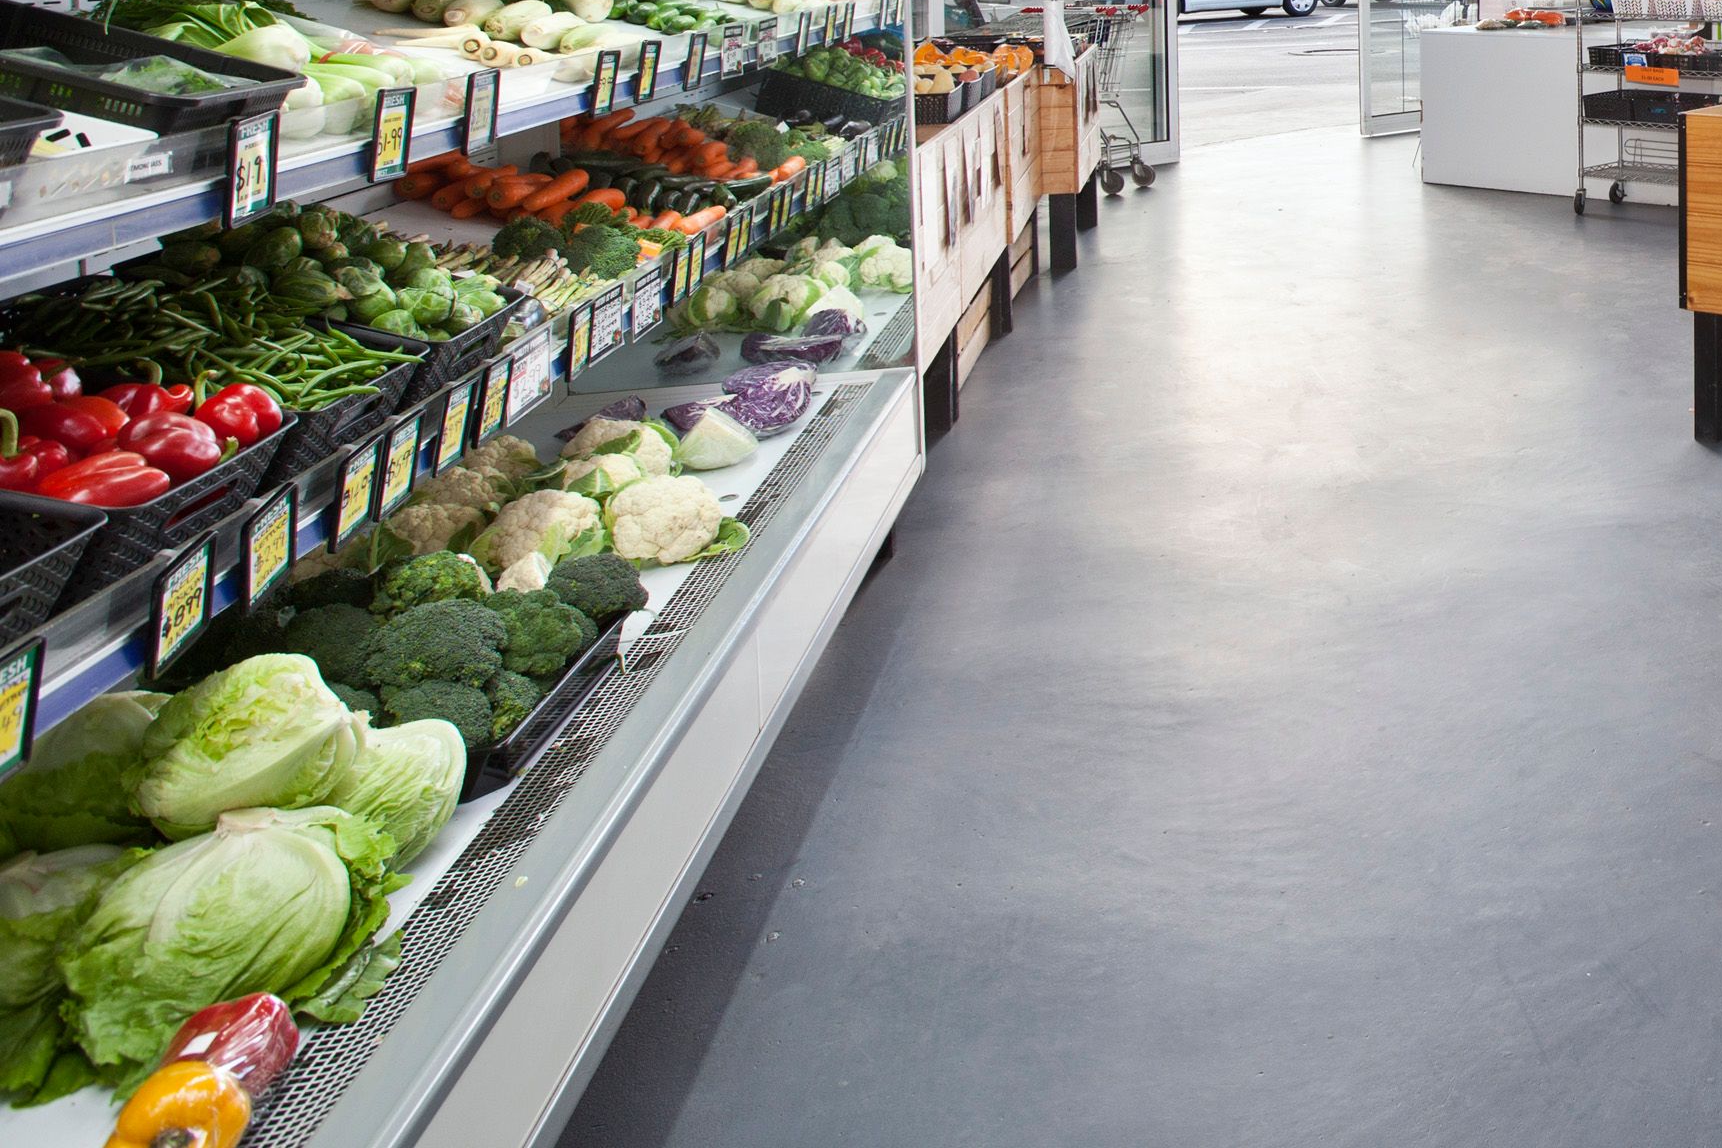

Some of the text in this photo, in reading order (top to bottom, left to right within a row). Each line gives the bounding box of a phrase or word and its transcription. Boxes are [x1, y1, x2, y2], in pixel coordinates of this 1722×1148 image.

[240, 121, 268, 138] FRESH
[167, 549, 205, 588] FRESH
[0, 655, 28, 685] ESH
